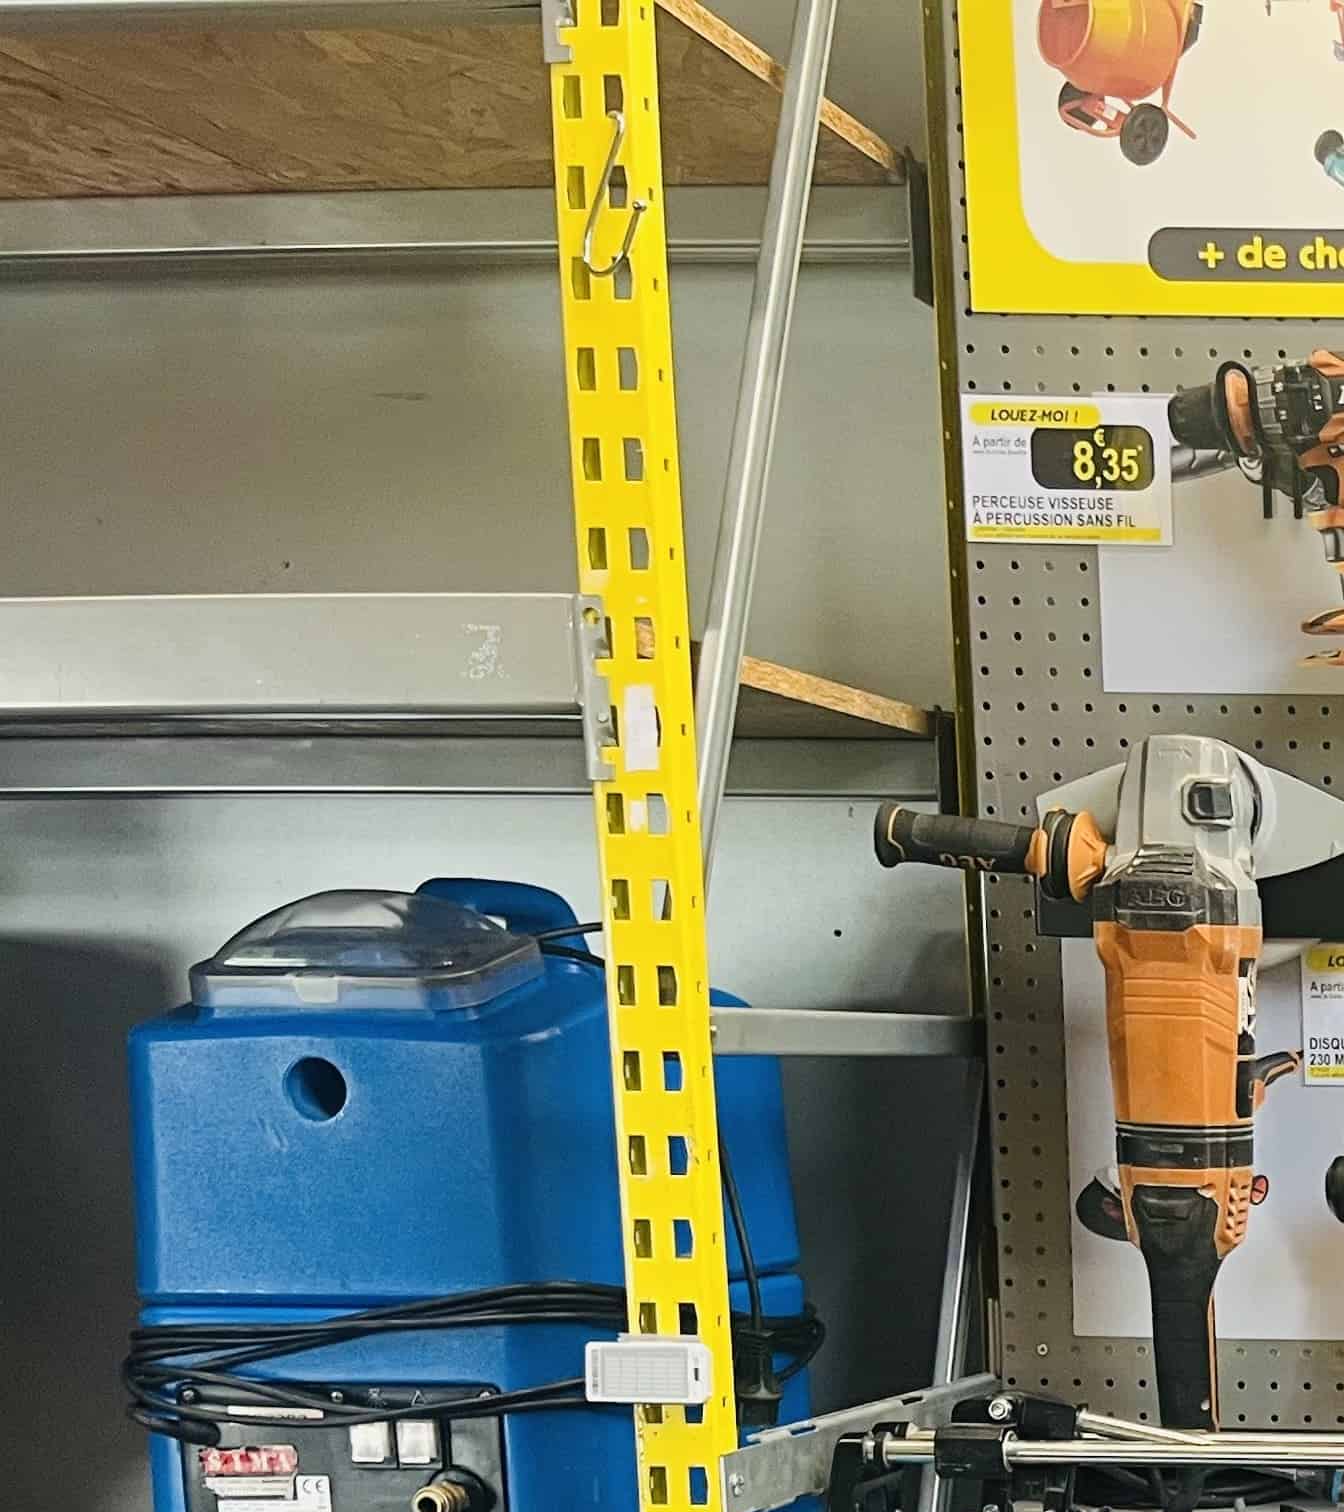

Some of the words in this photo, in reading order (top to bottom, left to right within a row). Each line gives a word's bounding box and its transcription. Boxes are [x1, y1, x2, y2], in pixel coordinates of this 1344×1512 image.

[1237, 237, 1287, 270] de
[991, 410, 1069, 421] LOUEZ-MOI
[983, 436, 1010, 448] partir
[1014, 434, 1027, 447] de
[972, 496, 1043, 509] PERCEUSE
[1049, 497, 1113, 510] VISSEUSE
[986, 512, 1073, 526] PERCUSSION
[1077, 514, 1112, 527] SANS
[1117, 515, 1135, 527] FIL
[1310, 1054, 1330, 1065] 230
